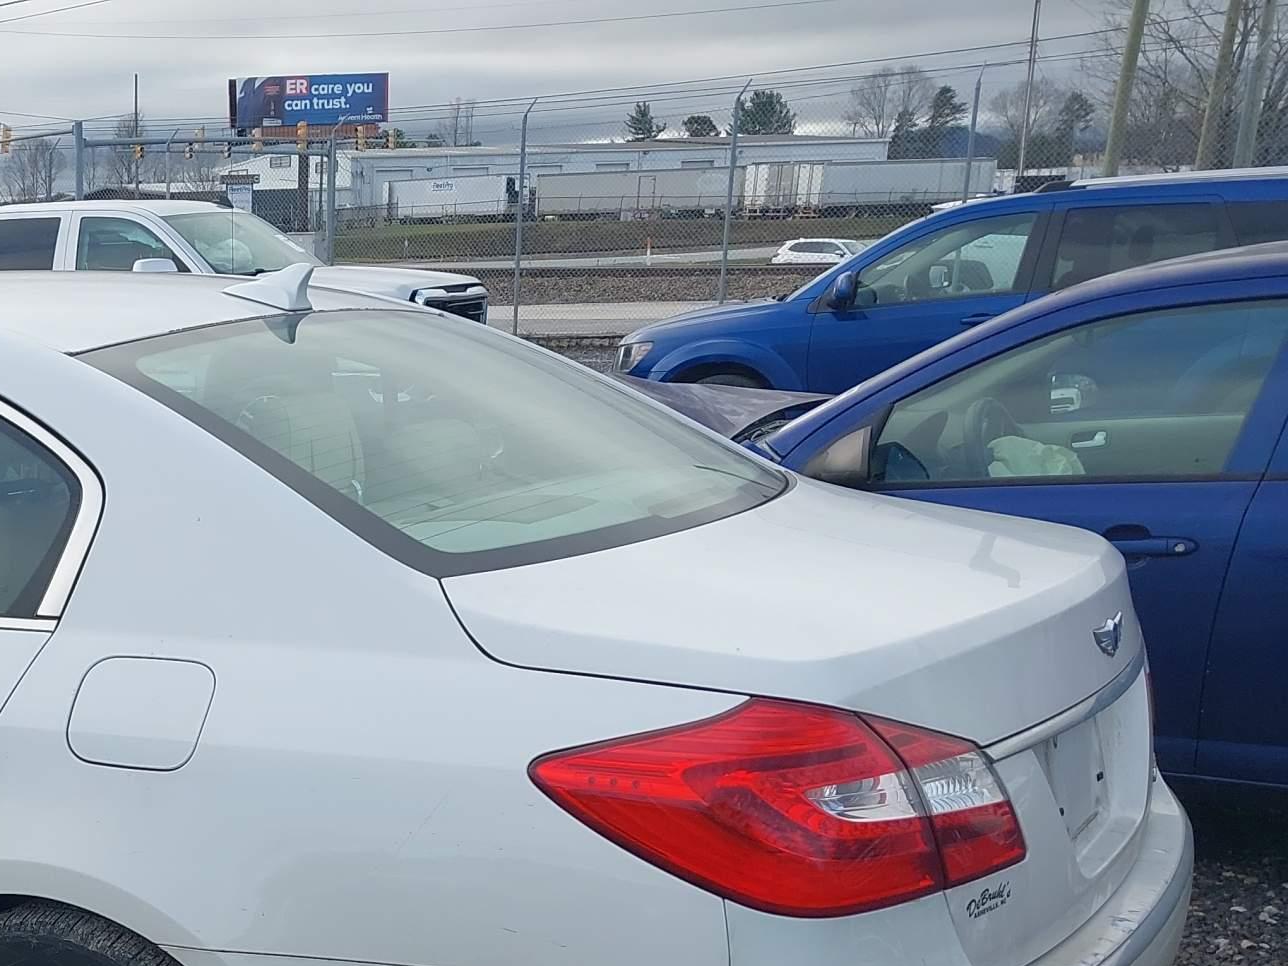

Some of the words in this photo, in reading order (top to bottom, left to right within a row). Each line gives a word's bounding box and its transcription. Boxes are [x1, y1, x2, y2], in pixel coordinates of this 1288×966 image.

[286, 80, 308, 94] ER
[311, 84, 343, 94] care
[347, 82, 373, 96] you
[284, 99, 310, 110] can
[312, 96, 350, 109] trust.
[966, 881, 1011, 918] DeBruhl's
